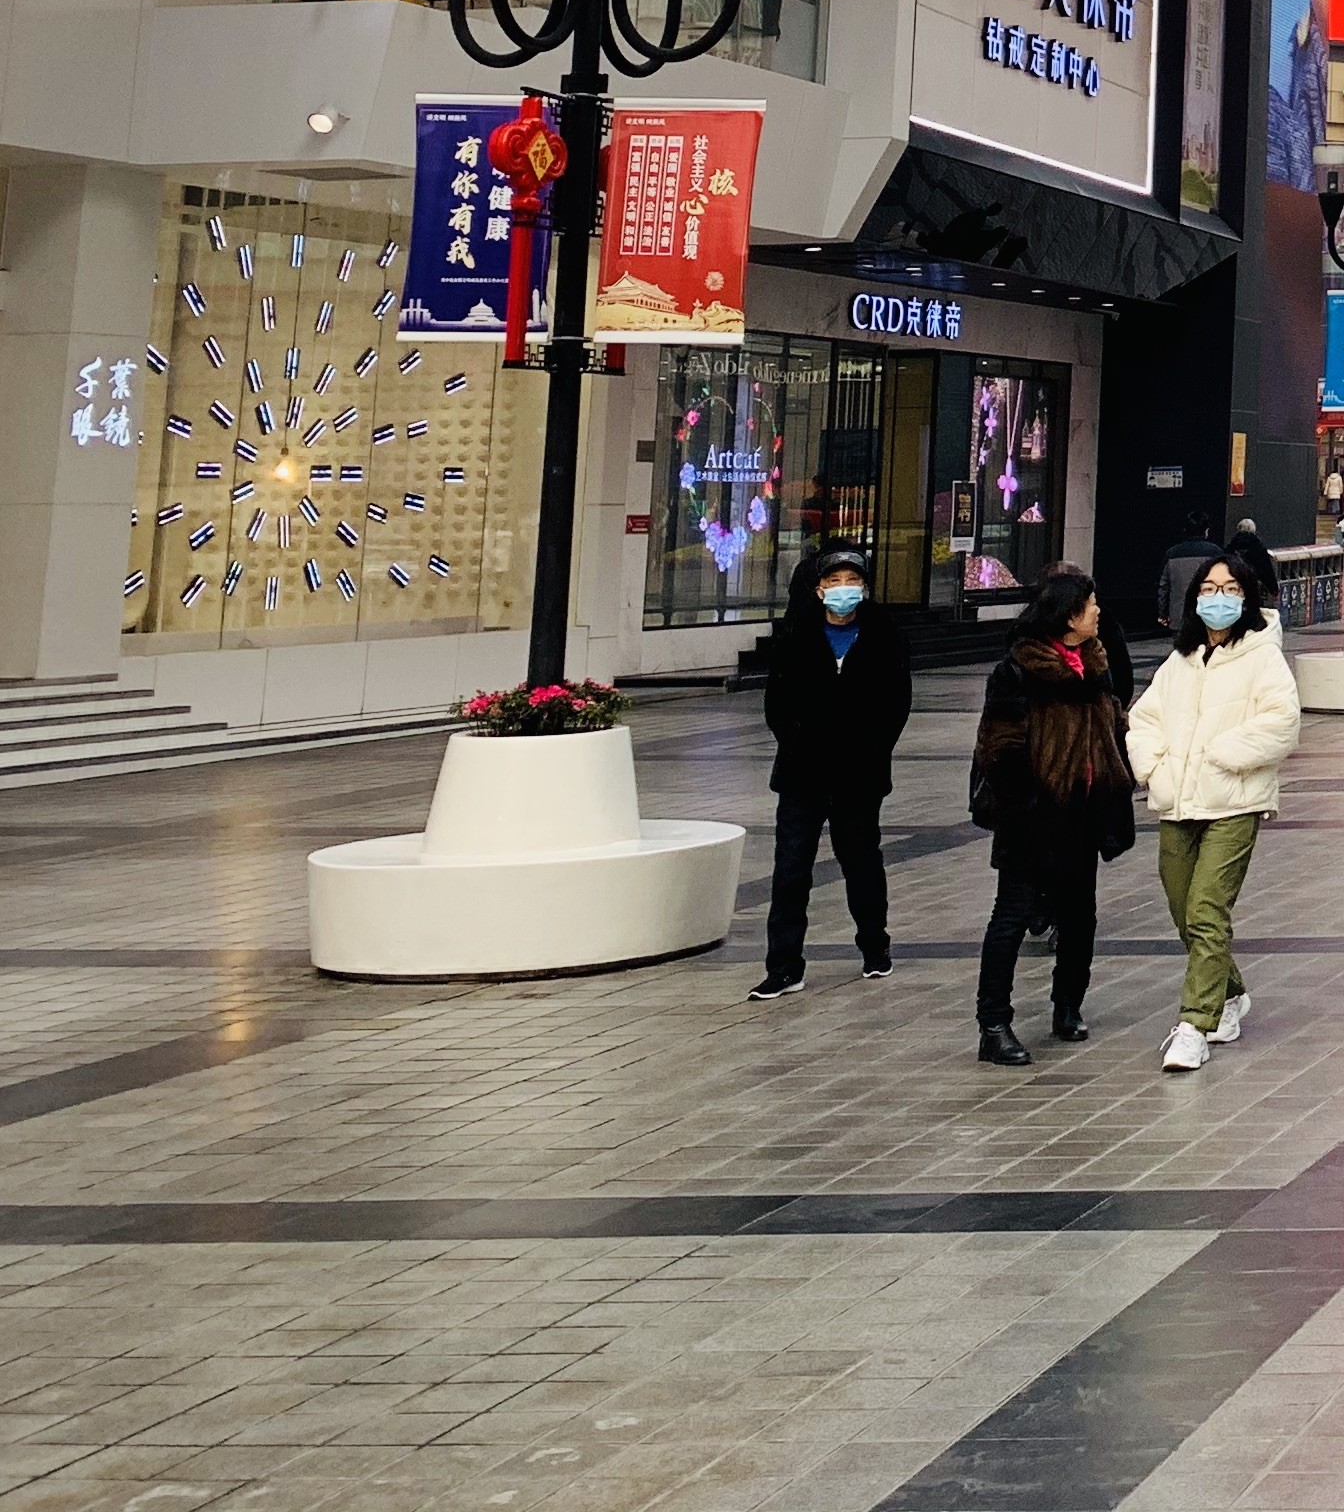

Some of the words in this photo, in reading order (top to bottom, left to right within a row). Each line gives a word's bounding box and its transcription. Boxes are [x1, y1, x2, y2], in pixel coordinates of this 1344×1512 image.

[984, 17, 1101, 96] 钻戒定制中心
[445, 136, 482, 270] 有你有我
[852, 294, 962, 339] CRD克徕帝
